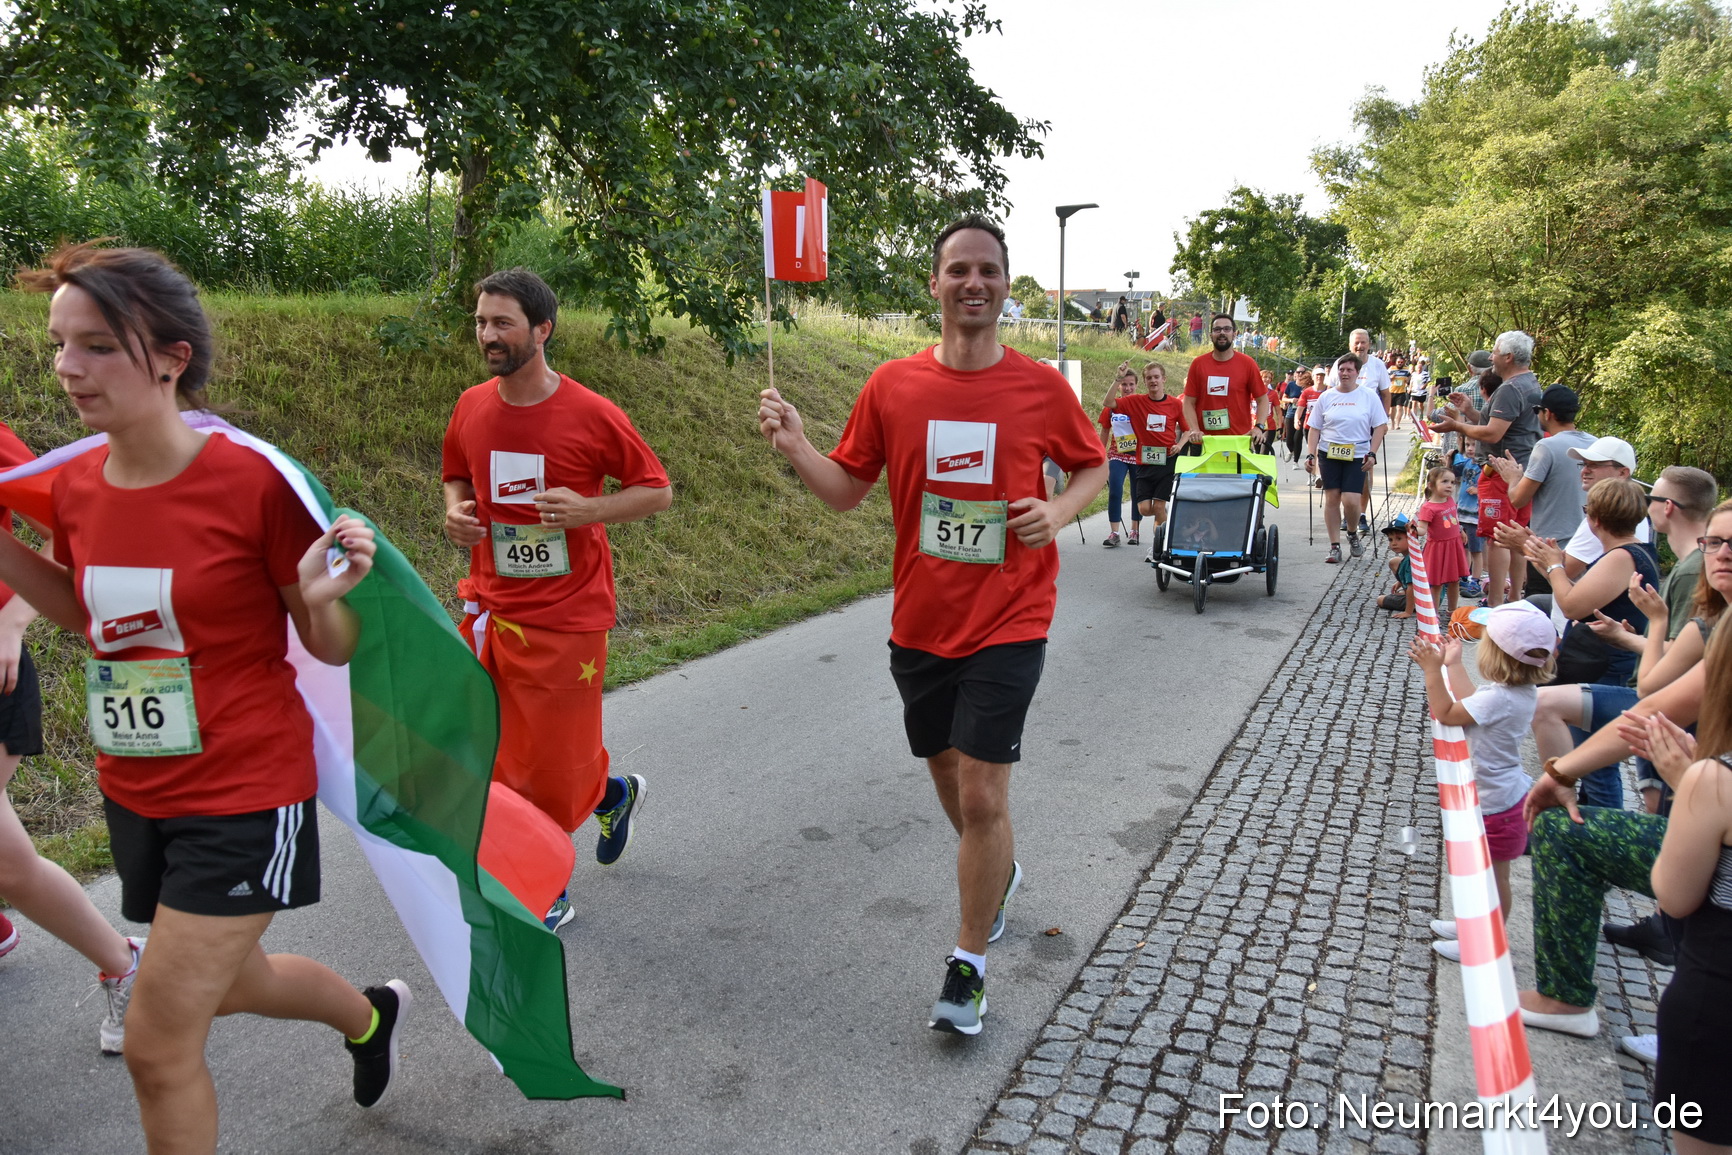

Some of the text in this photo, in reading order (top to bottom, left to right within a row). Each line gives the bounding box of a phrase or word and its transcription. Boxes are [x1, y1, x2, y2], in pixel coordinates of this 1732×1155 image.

[1119, 440, 1137, 449] 2064
[1331, 446, 1351, 455] 1168
[948, 456, 971, 468] DEHN
[508, 482, 527, 492] DEHN
[937, 520, 986, 546] 517
[507, 543, 550, 563] 496
[939, 542, 982, 553] Meier Florian
[116, 619, 144, 635] DEHN
[158, 684, 184, 694] 2019
[103, 695, 165, 730] 516
[135, 731, 159, 740] Anna
